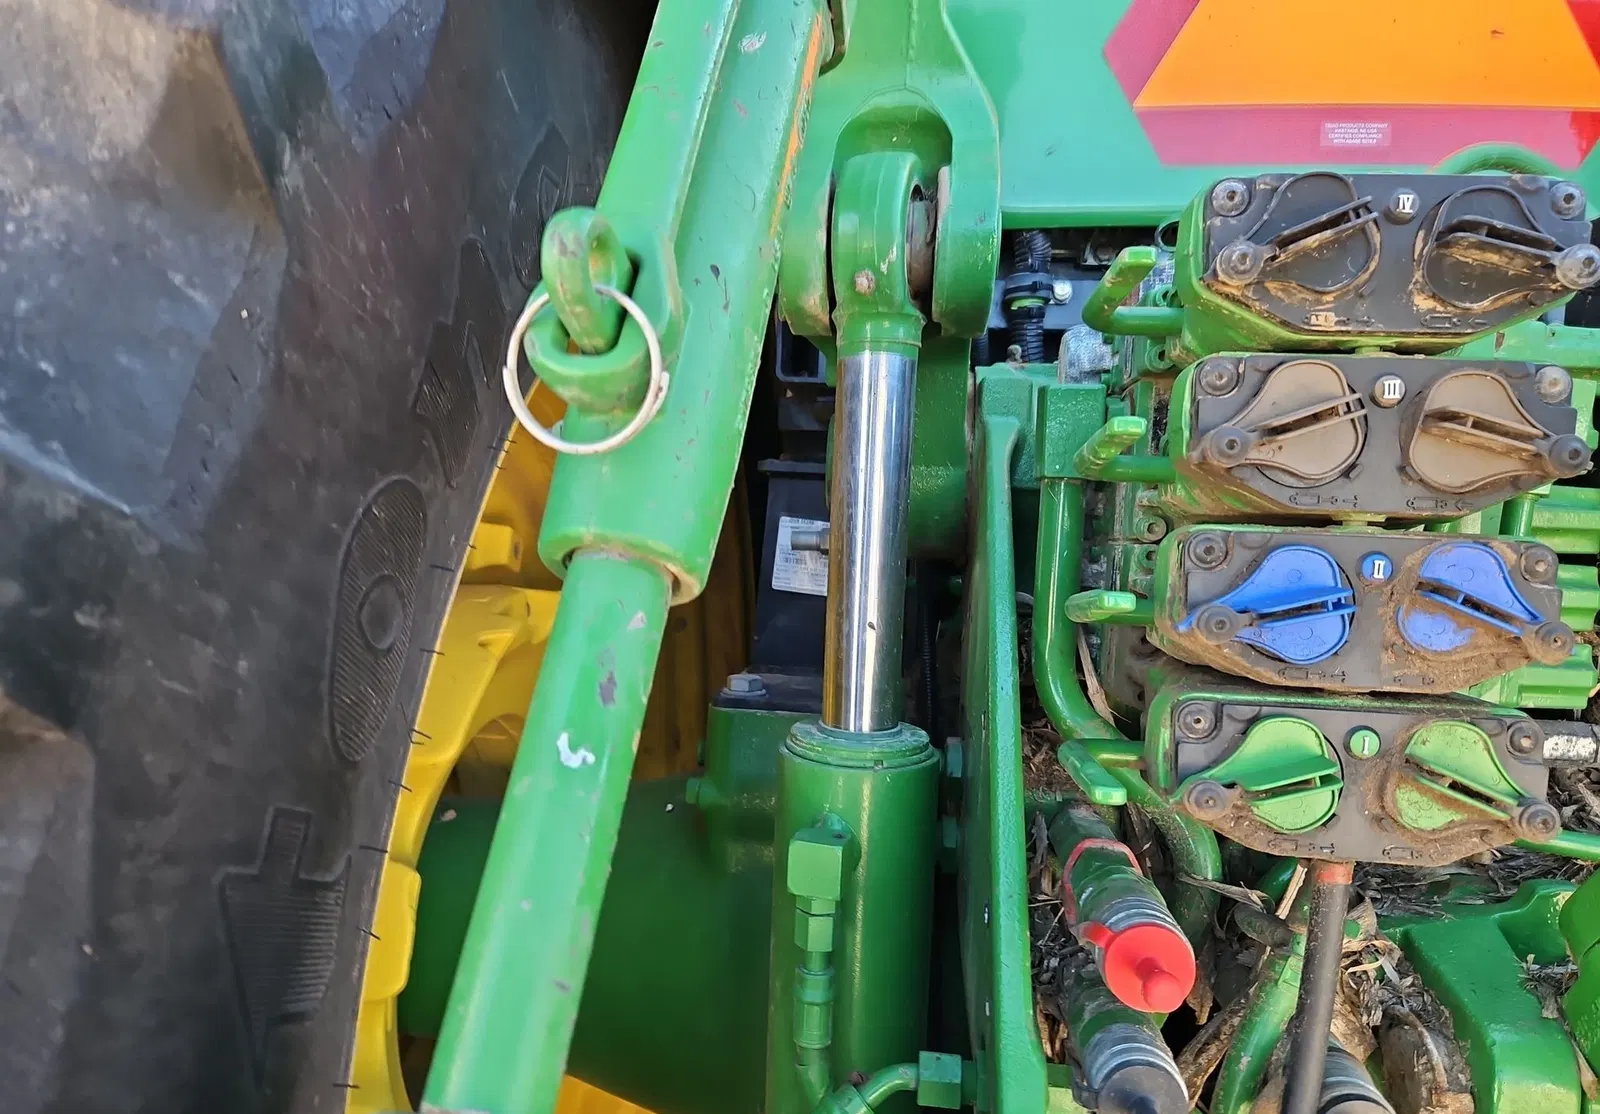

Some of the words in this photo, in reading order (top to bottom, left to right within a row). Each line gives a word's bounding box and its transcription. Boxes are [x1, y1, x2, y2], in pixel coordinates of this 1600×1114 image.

[1396, 194, 1414, 213] IV
[1383, 379, 1401, 399] III
[1373, 559, 1385, 579] II
[1362, 736, 1370, 755] I
